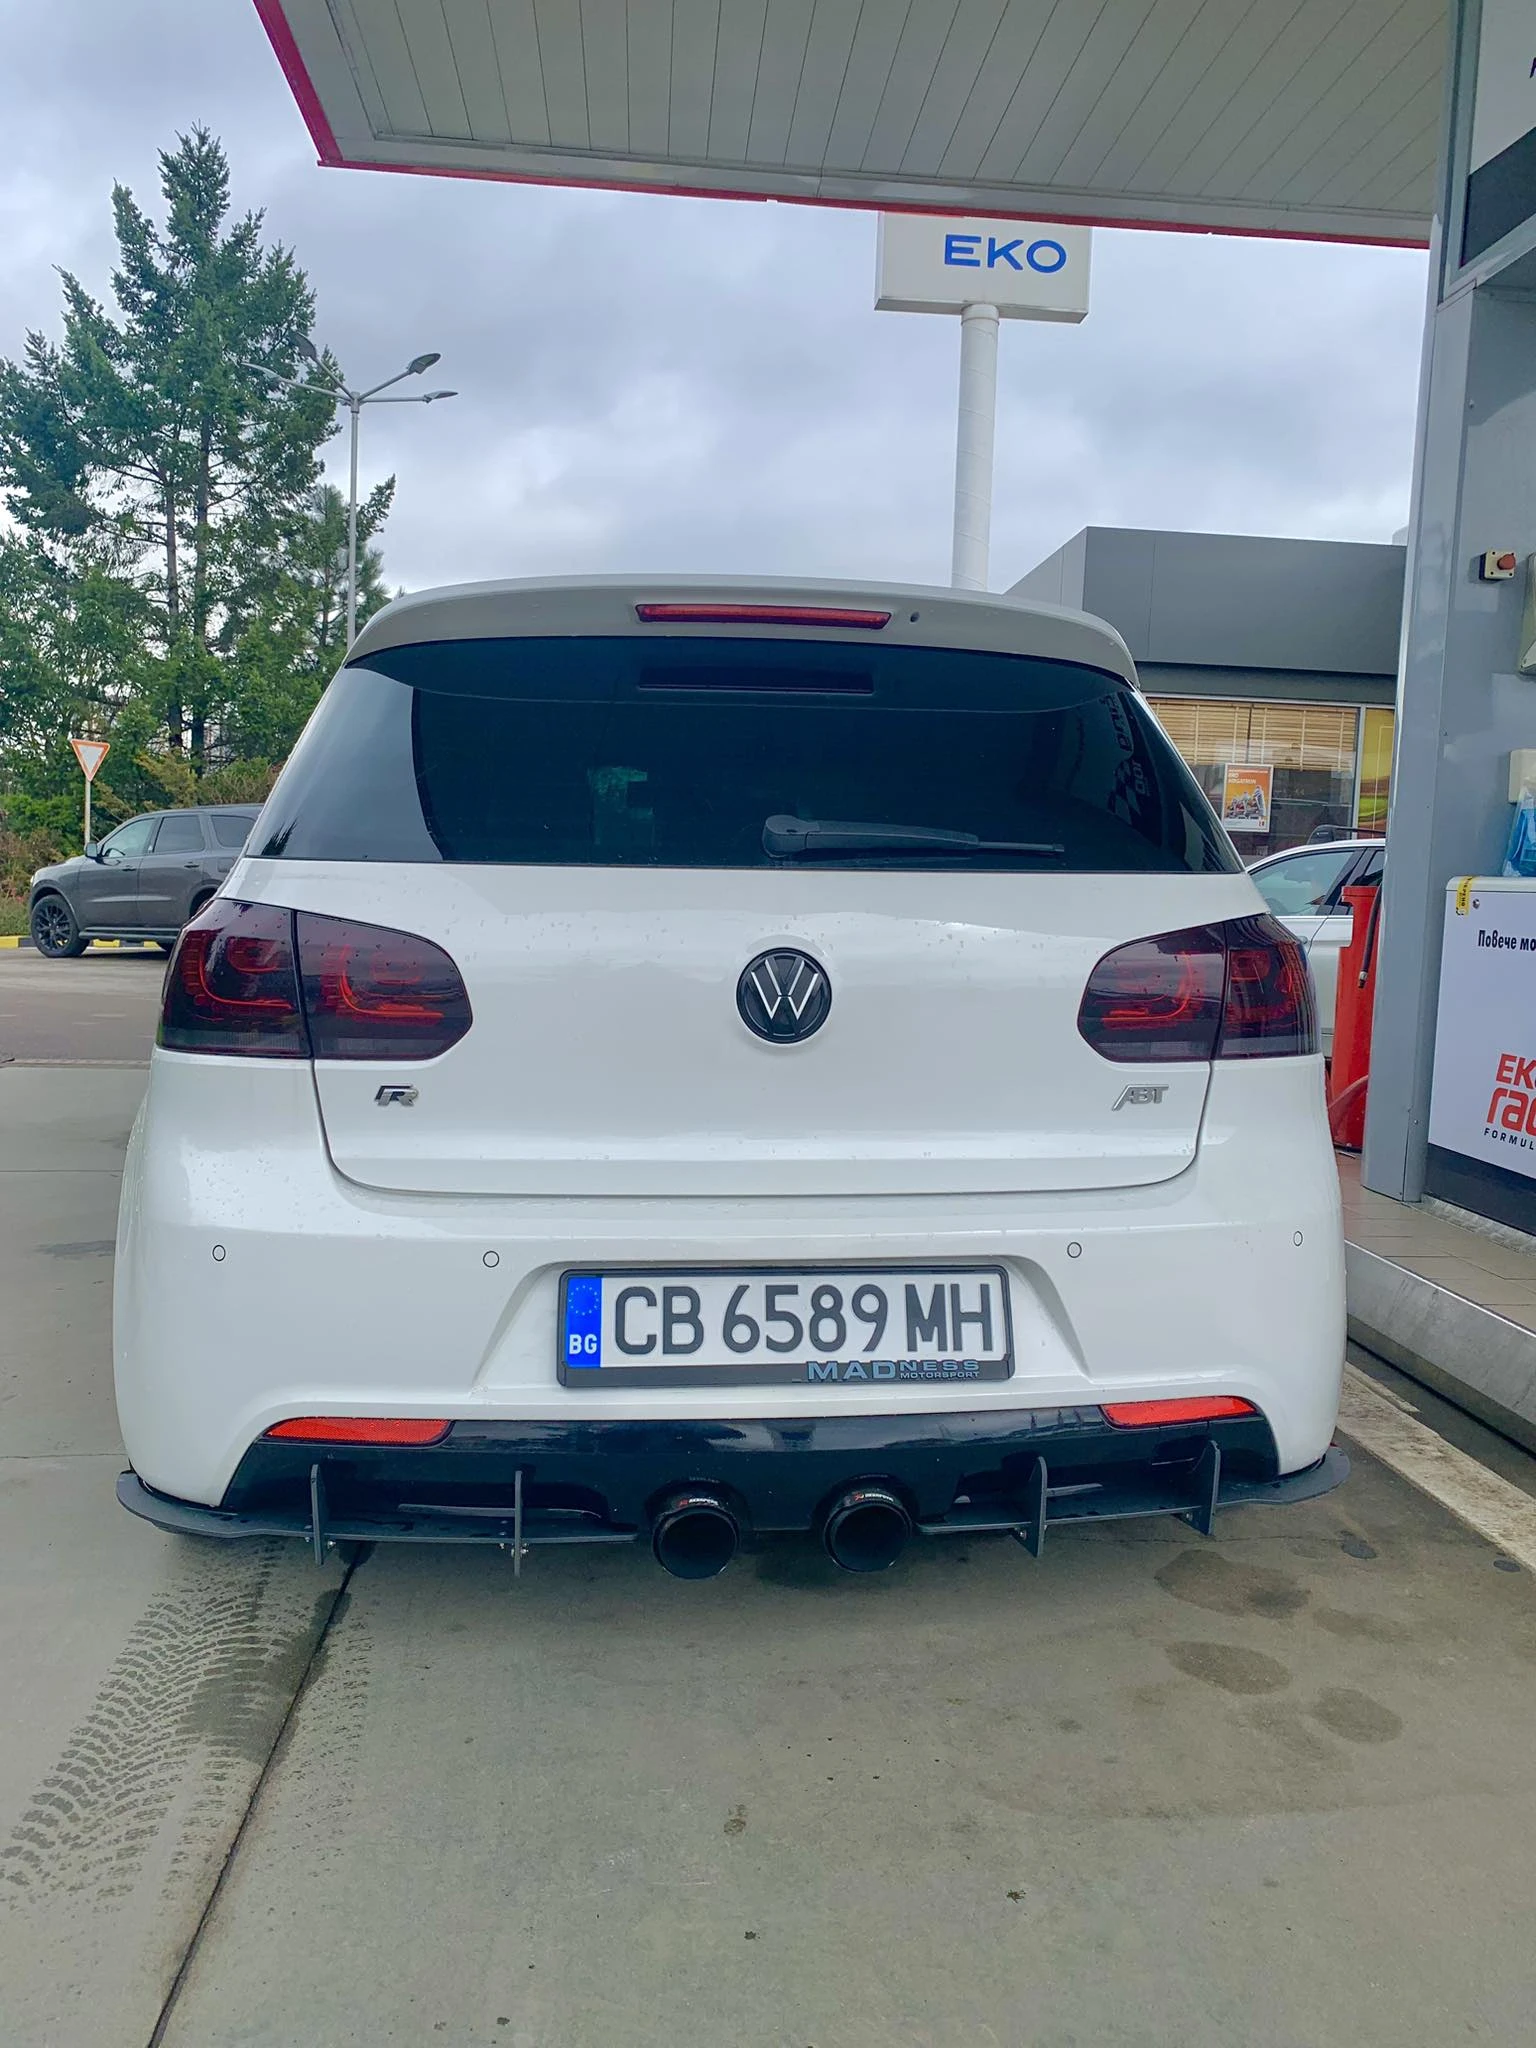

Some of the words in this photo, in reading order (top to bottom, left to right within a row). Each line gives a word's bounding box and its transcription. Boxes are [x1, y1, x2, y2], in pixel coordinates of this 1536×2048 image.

[945, 234, 1067, 273] EKO
[1478, 929, 1517, 950] Повече
[1495, 1053, 1536, 1090] EK
[1112, 1084, 1169, 1111] ABT
[615, 1286, 704, 1355] CB
[722, 1284, 888, 1354] 6589
[904, 1283, 993, 1353] MH
[569, 1333, 597, 1354] BG
[807, 1360, 980, 1380] MADNESS
[900, 1371, 980, 1379] MOTORSPORT
